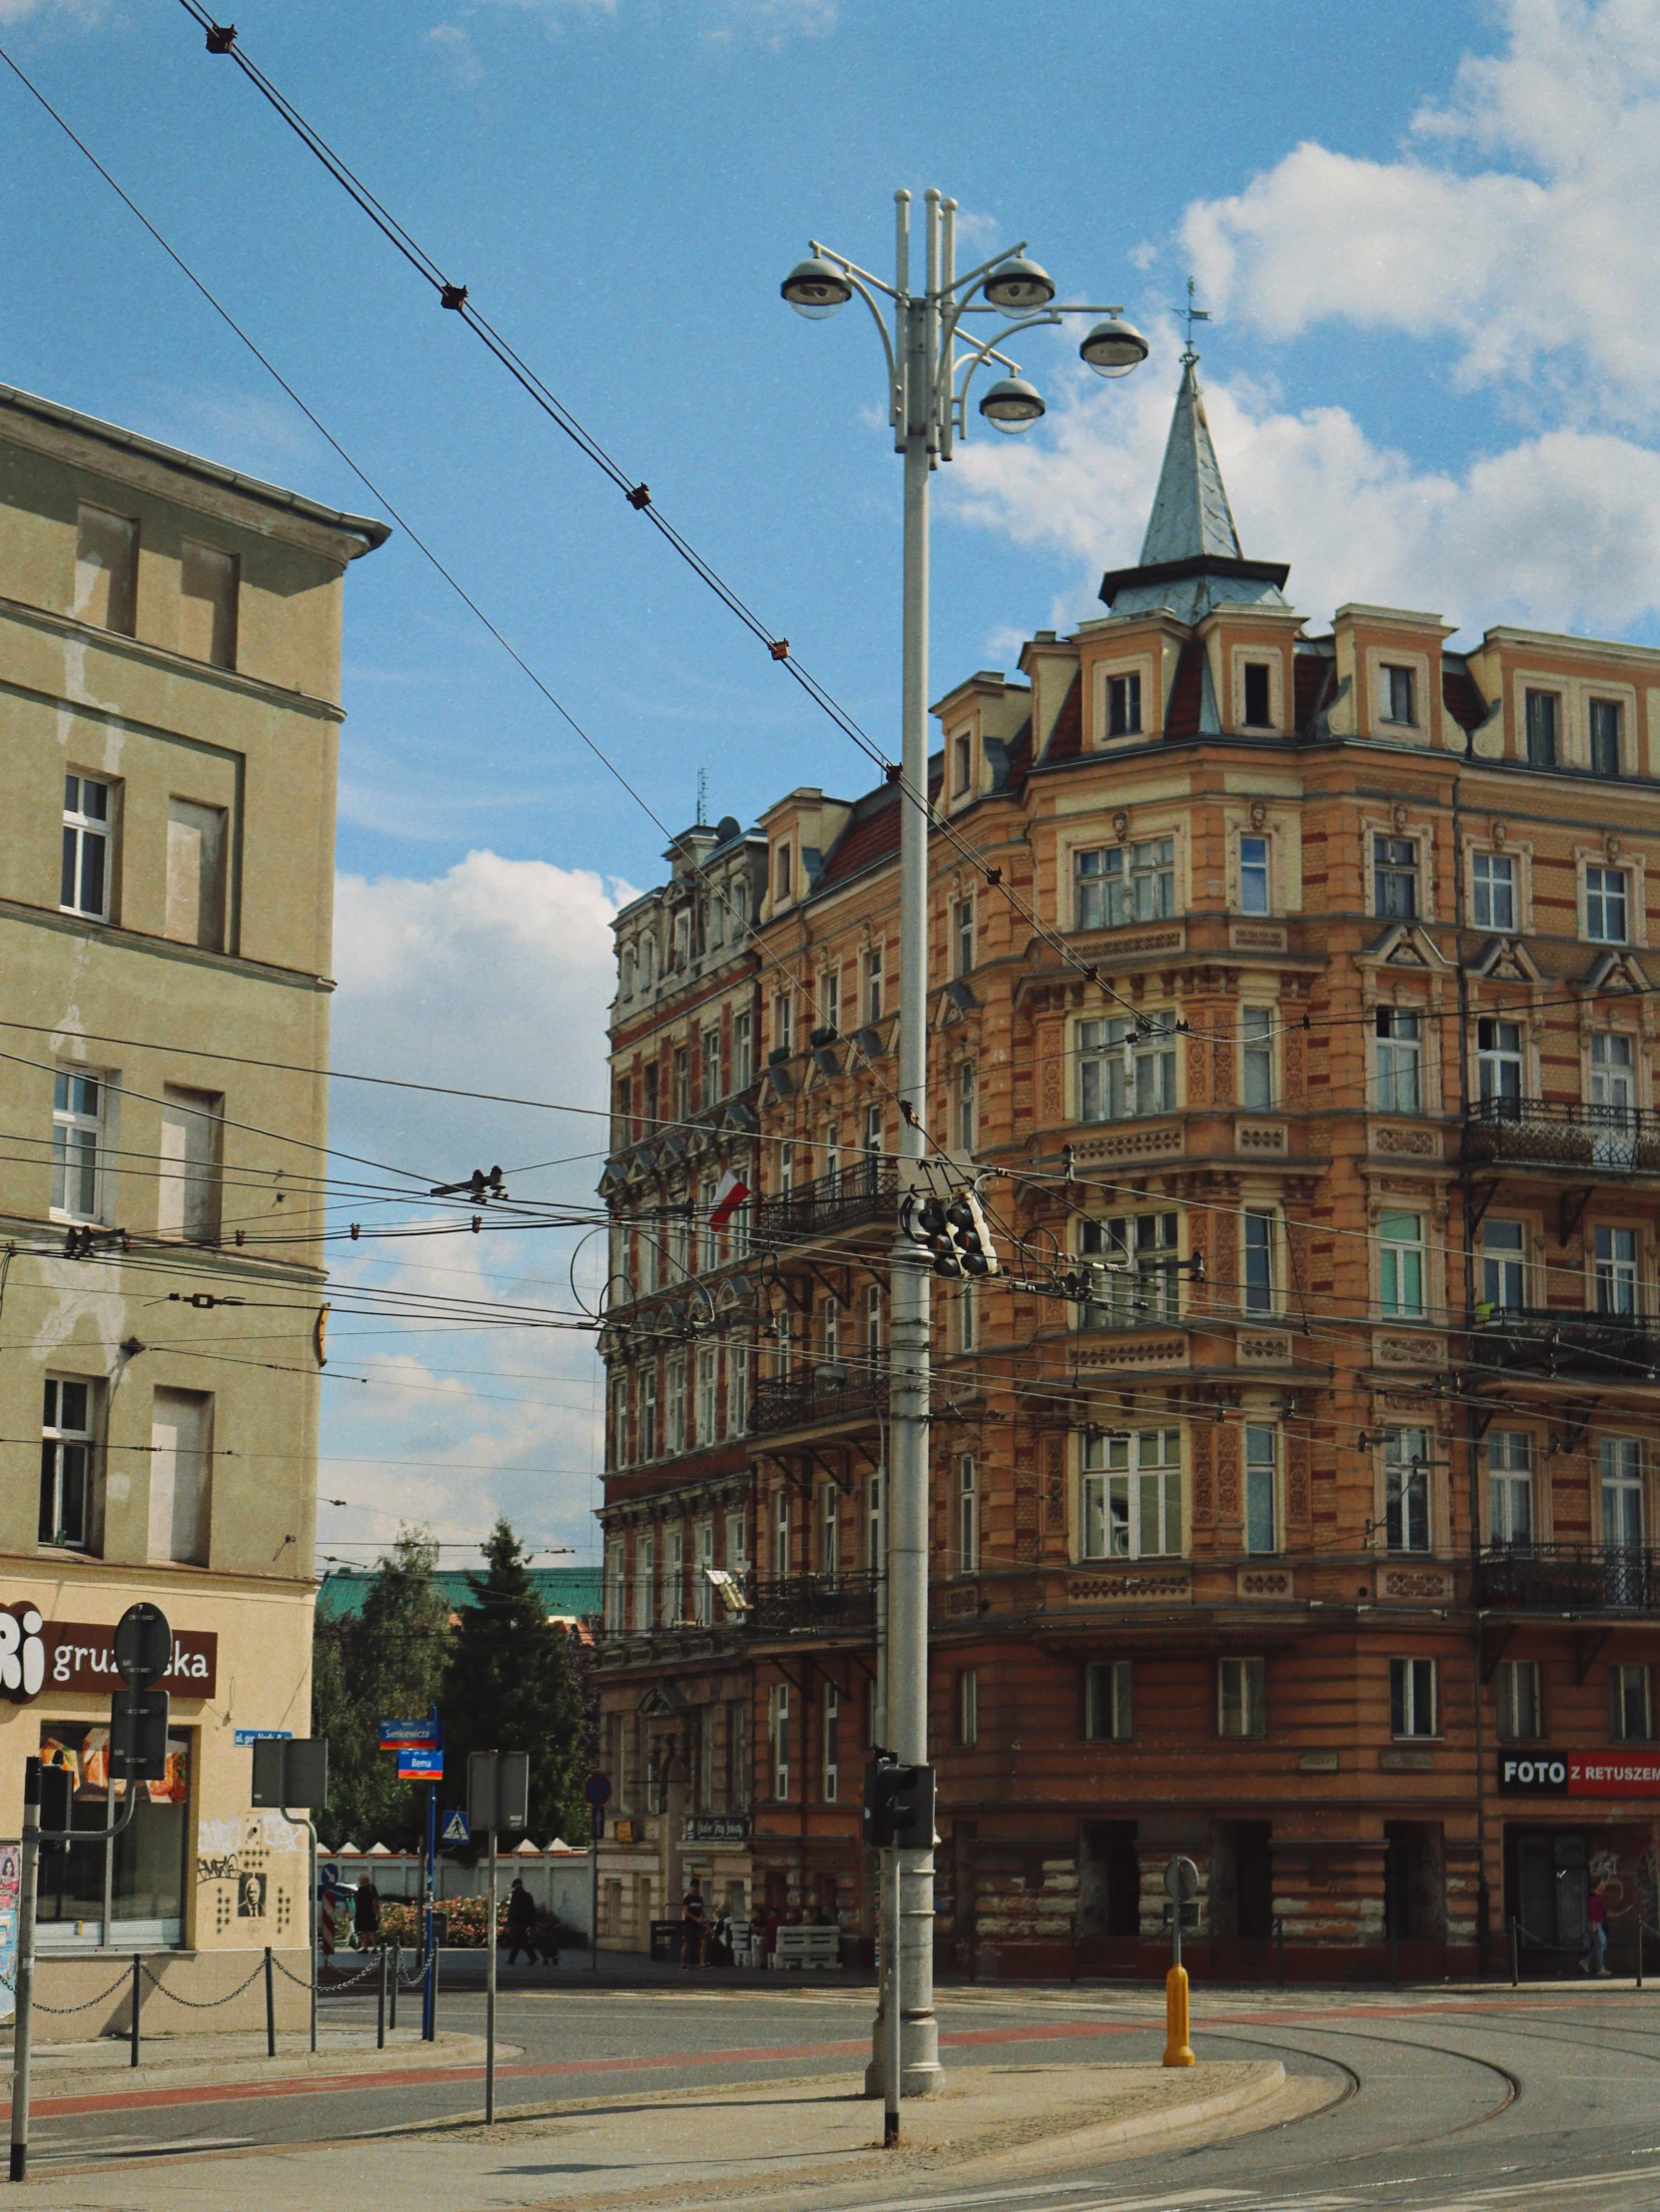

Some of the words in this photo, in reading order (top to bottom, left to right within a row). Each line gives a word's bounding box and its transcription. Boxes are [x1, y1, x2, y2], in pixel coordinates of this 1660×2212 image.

[386, 1729, 429, 1739] Sienkiewicza
[1503, 1761, 1565, 1784] FOTO
[1570, 1766, 1581, 1780] Z
[1585, 1767, 1660, 1782] RETUSZEM
